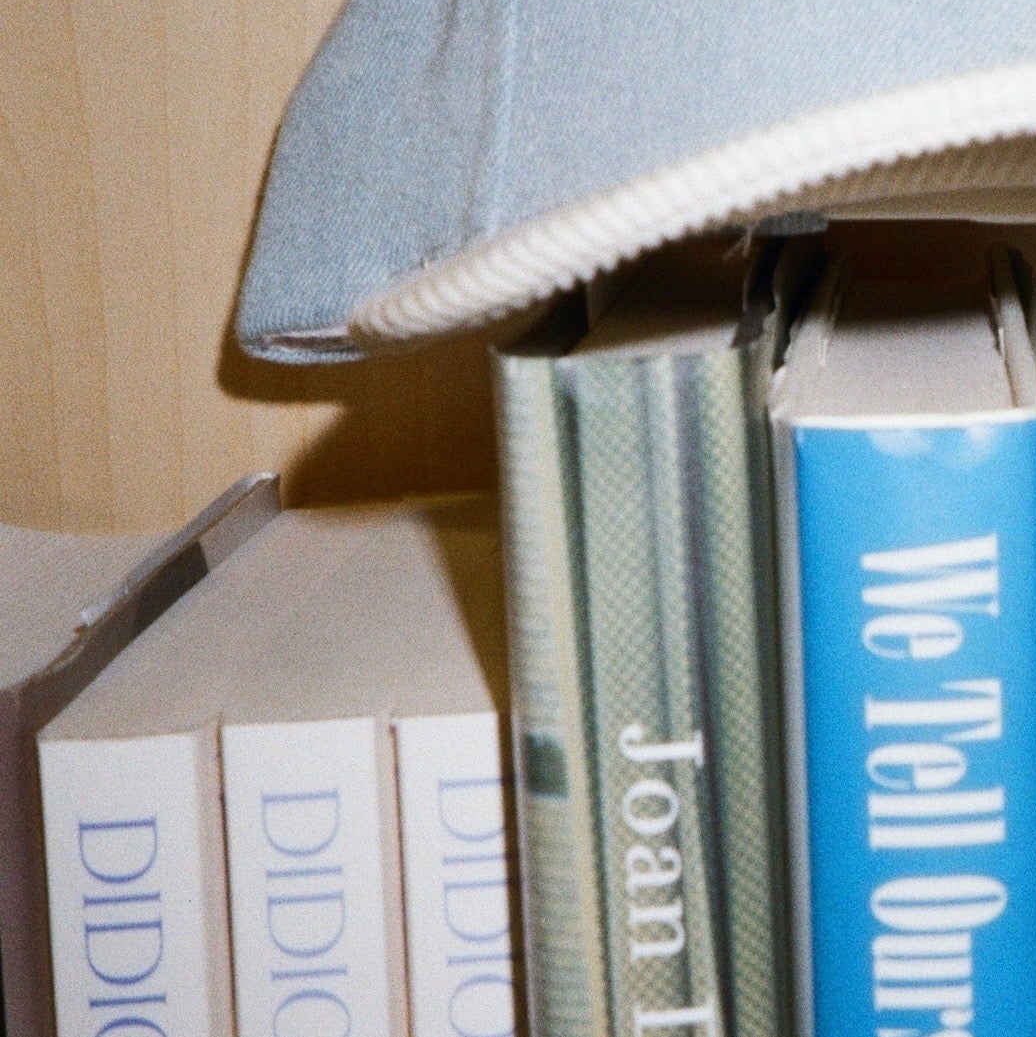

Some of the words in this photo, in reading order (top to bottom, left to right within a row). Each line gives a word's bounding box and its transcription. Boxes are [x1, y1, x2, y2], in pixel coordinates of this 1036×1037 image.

[859, 533, 1000, 660] We
[616, 723, 704, 962] Joan
[864, 678, 1006, 851] Tell
[869, 874, 1009, 1037] Our
